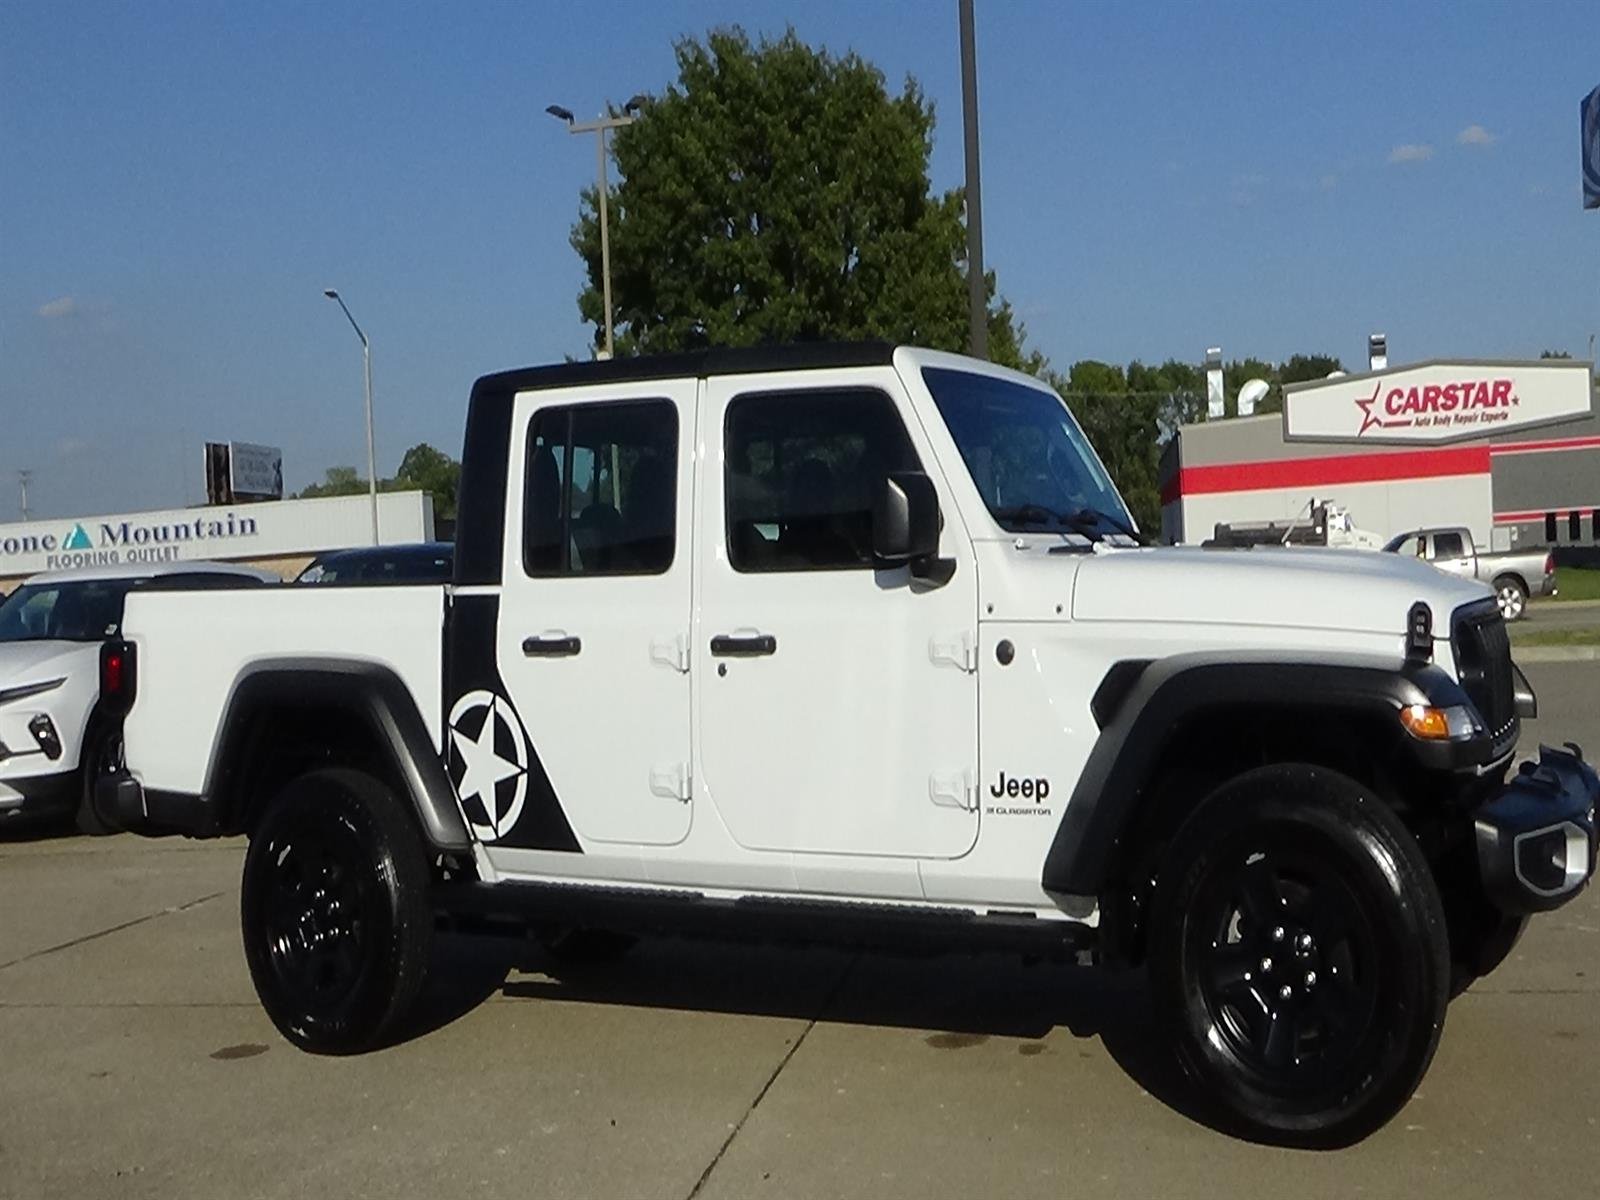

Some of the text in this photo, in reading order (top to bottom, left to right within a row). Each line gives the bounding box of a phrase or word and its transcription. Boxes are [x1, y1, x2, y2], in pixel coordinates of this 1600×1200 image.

[1385, 380, 1512, 416] CARSTAR
[1414, 416, 1431, 427] Auto
[1433, 415, 1452, 427] Body
[1454, 412, 1479, 425] Repair
[0, 513, 259, 554] one Mountain
[47, 546, 180, 569] FLOORING OUTLET
[990, 771, 1049, 804] Jeep
